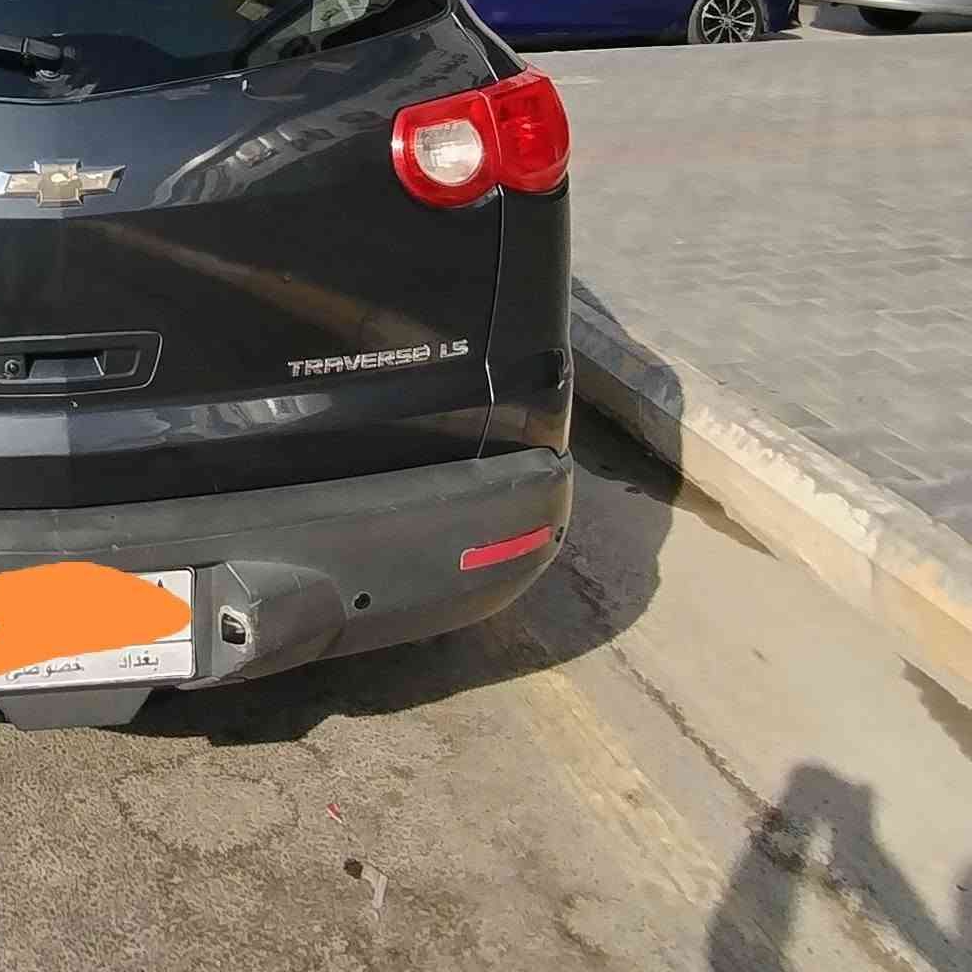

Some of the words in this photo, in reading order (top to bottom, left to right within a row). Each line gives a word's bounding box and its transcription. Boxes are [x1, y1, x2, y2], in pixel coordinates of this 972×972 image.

[287, 344, 431, 378] TRAVERSE
[439, 339, 469, 359] LS
[119, 650, 160, 671] بغداد
